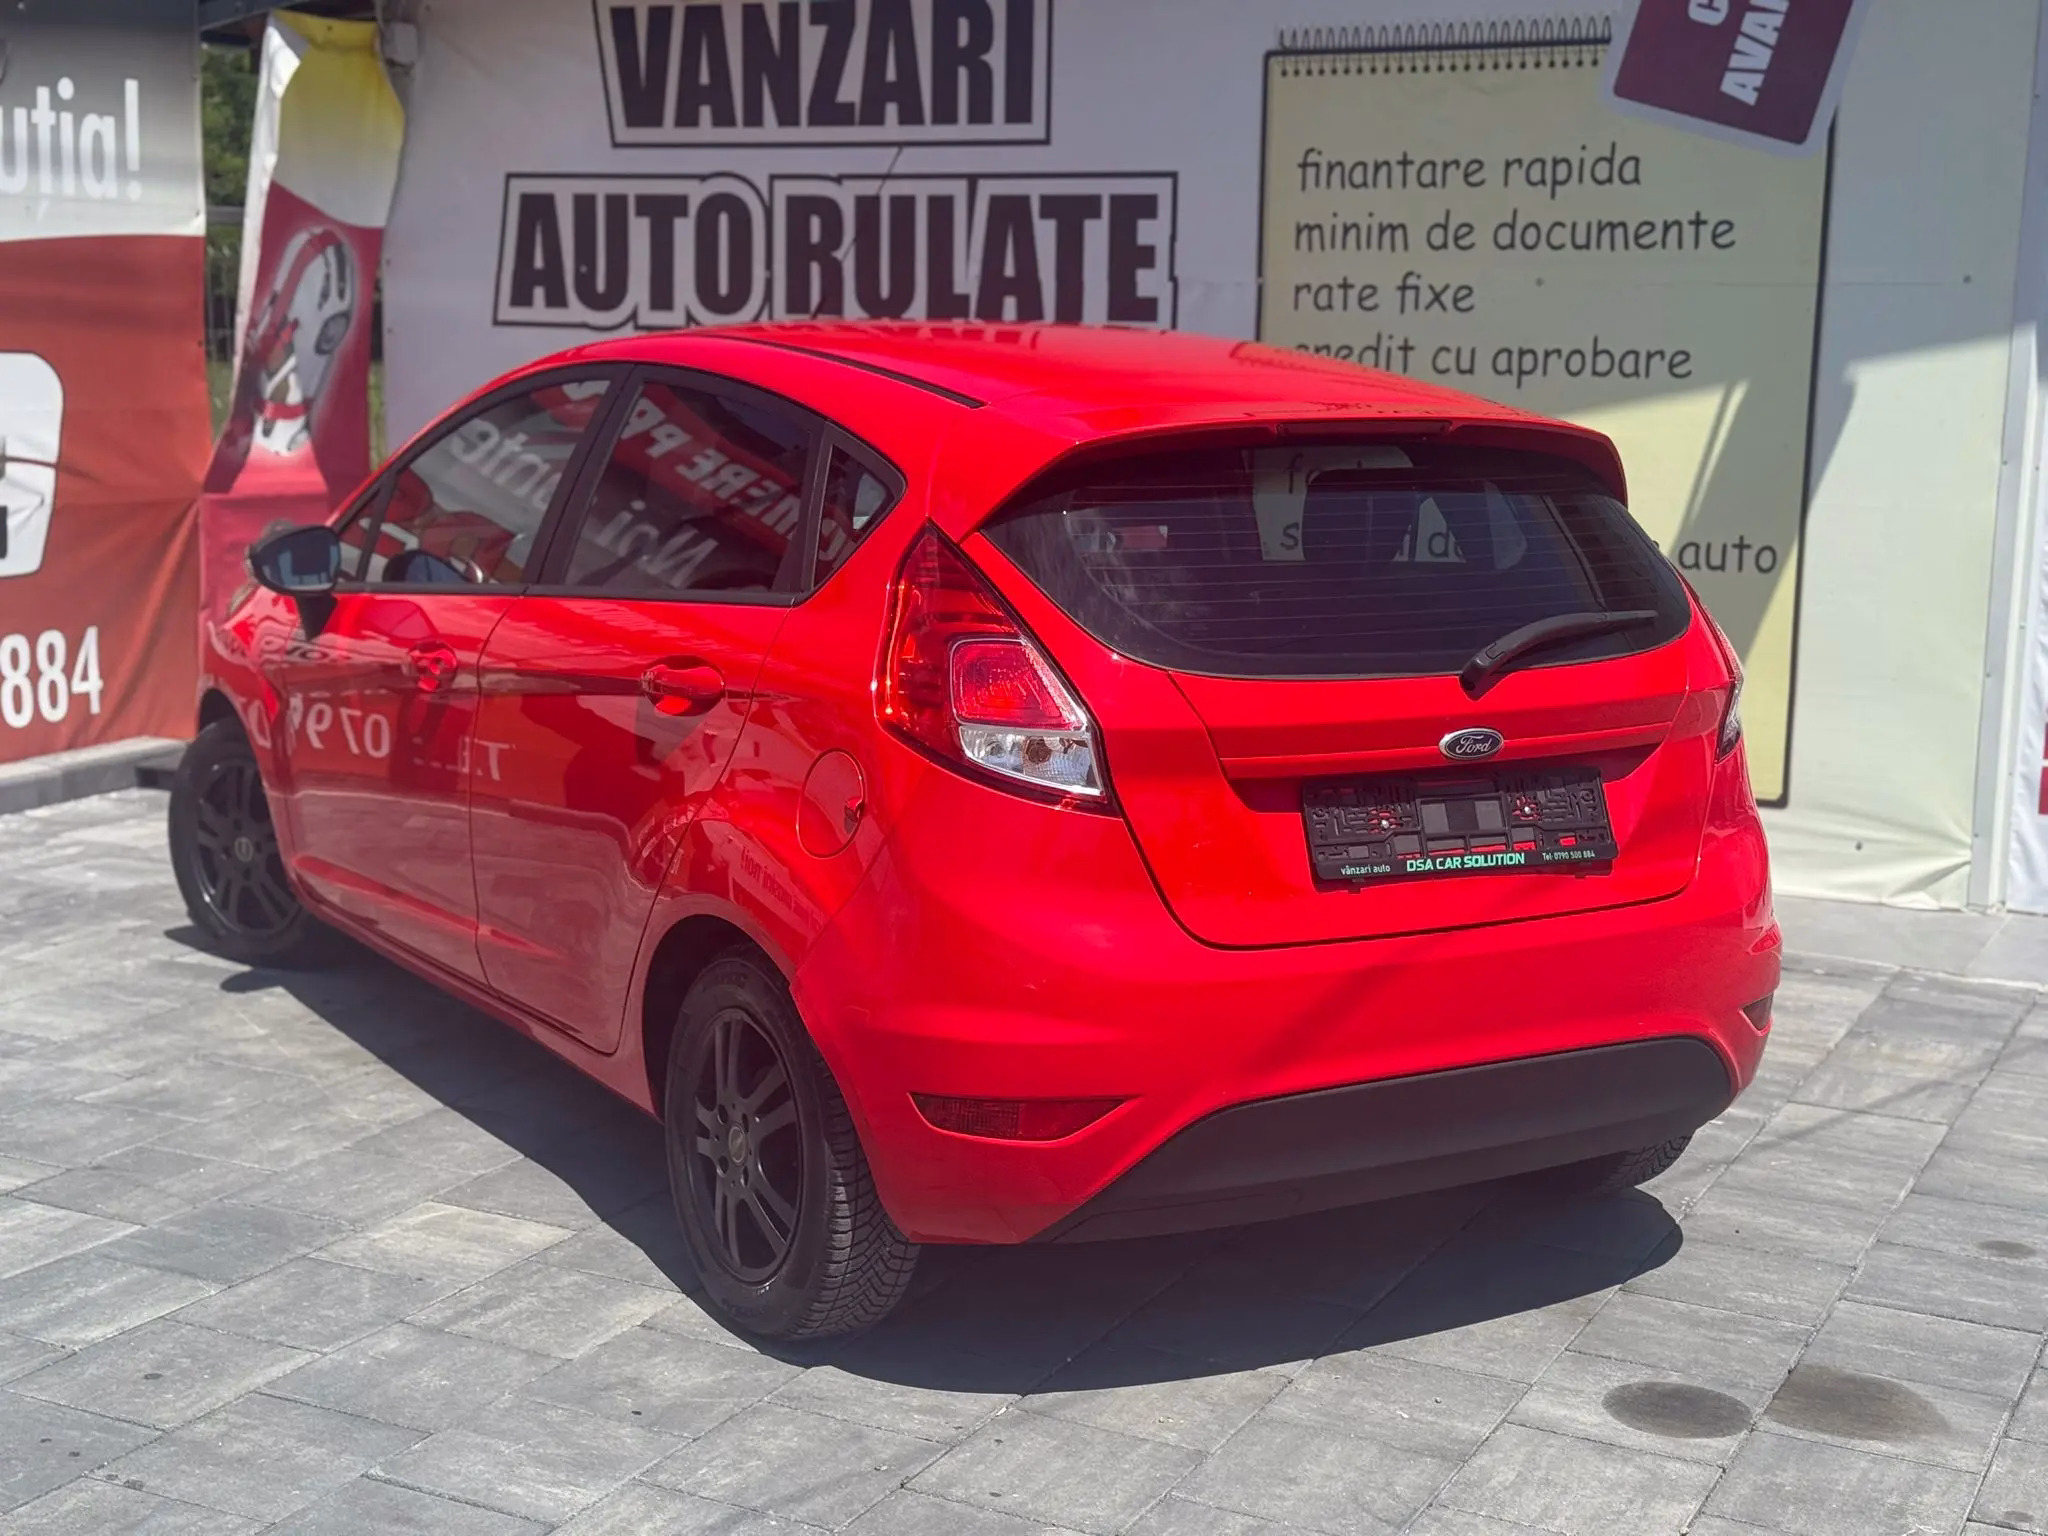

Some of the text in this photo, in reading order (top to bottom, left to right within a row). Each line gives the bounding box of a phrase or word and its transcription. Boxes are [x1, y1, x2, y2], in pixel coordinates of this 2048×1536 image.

[612, 0, 1033, 128] VANZARI
[1297, 142, 1642, 200] finantare rapida
[1294, 208, 1736, 253] minim de documente
[508, 192, 1159, 322] AUTO RULATE
[1293, 271, 1476, 315] rate fixe
[1431, 344, 1477, 376] cu
[1491, 336, 1693, 388] aprobare
[1677, 534, 1778, 574] auto
[0, 625, 104, 729] 884
[1455, 734, 1493, 754] Ford
[1373, 864, 1391, 874] auto
[1406, 852, 1526, 872] DSA CAR SOLUTION
